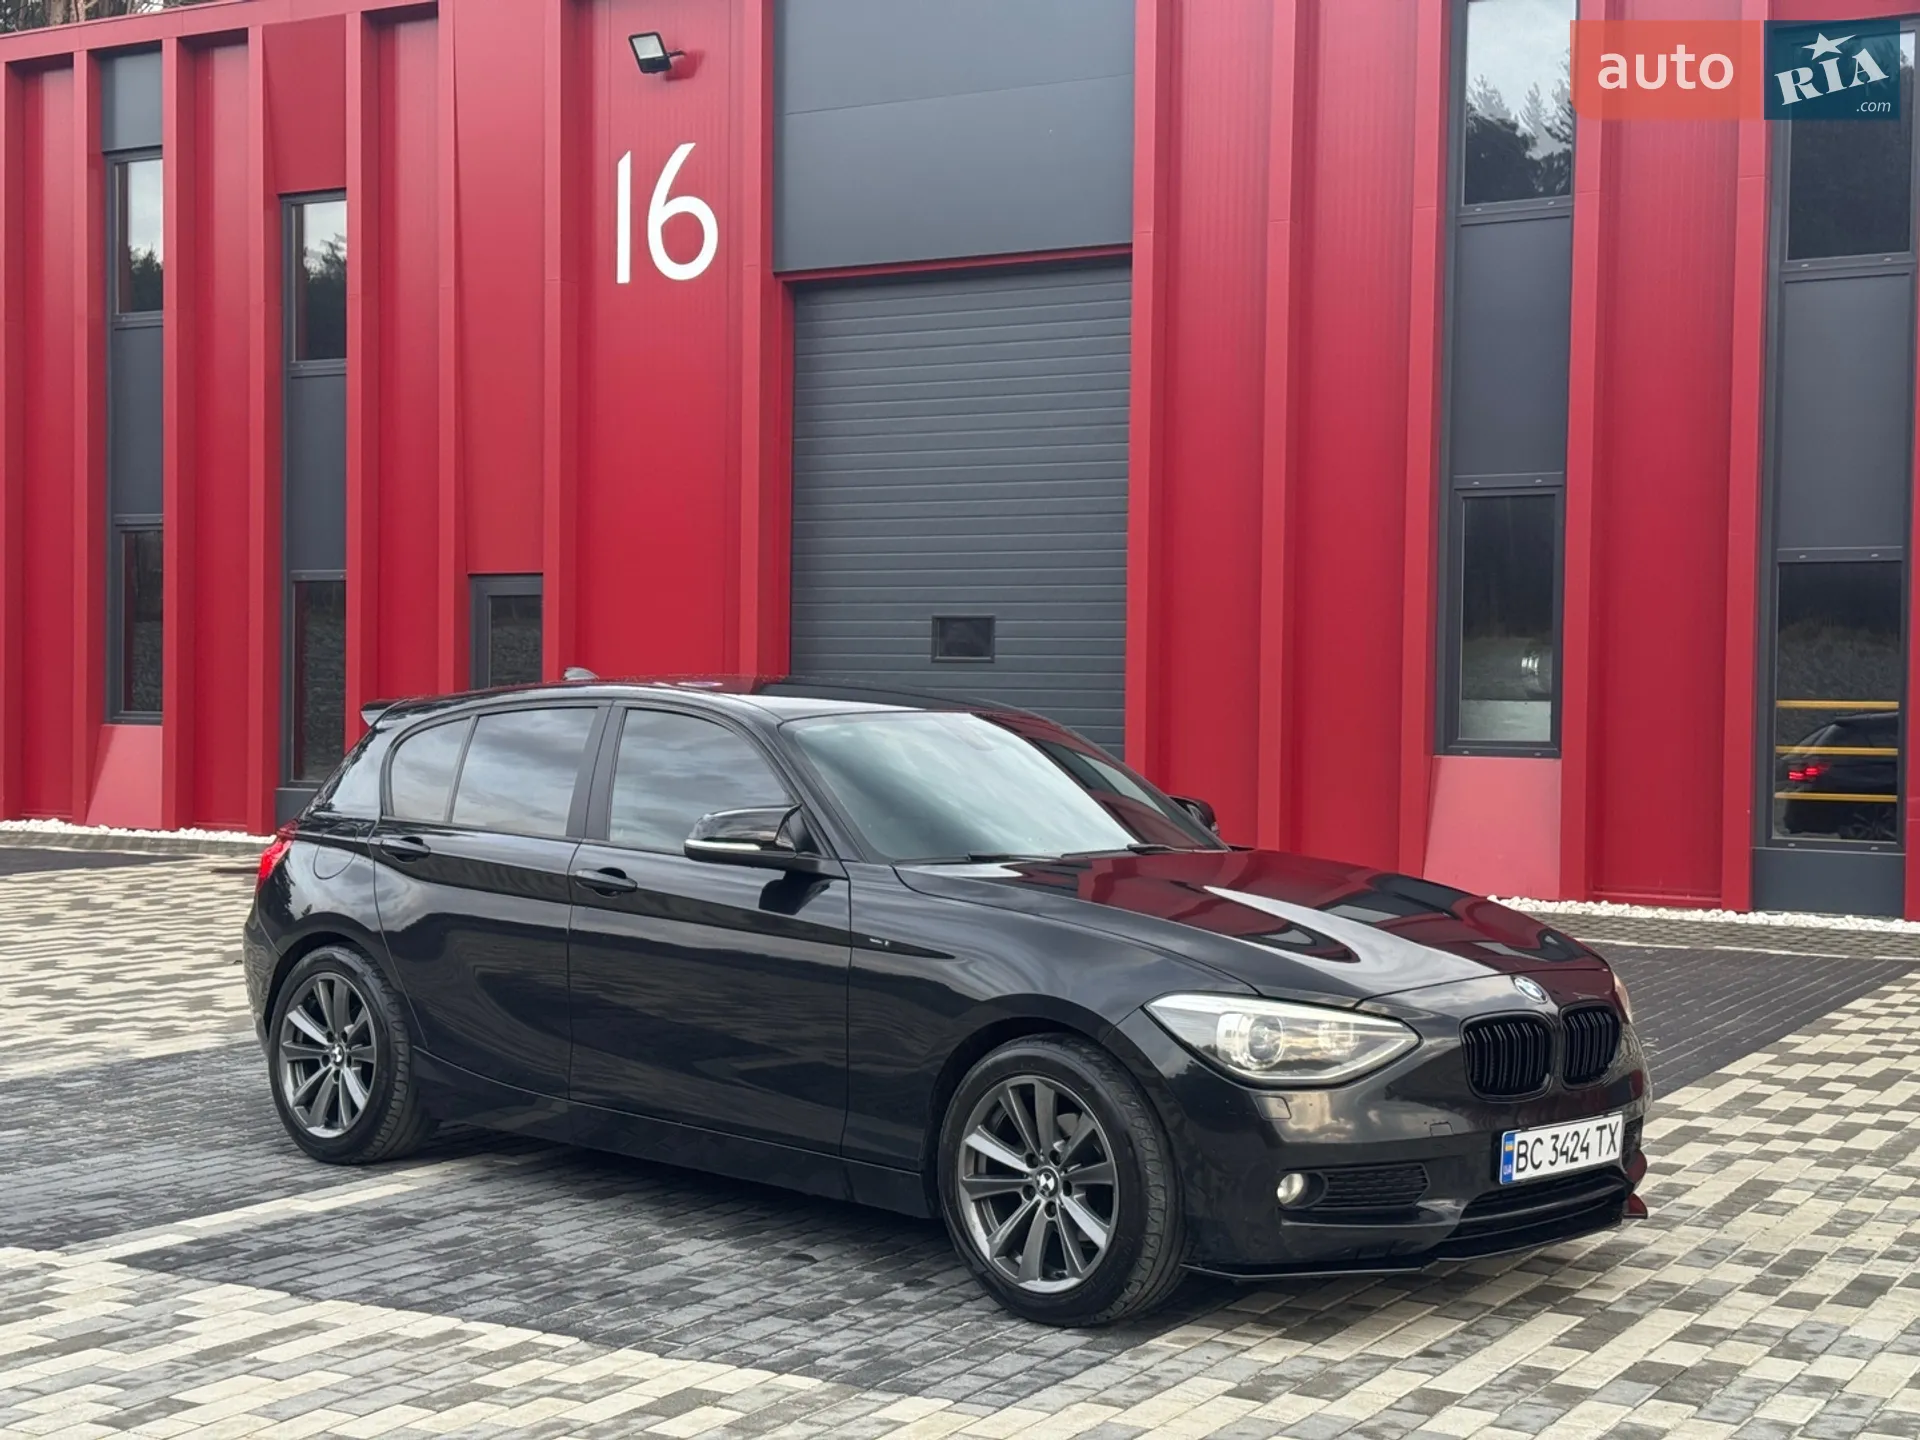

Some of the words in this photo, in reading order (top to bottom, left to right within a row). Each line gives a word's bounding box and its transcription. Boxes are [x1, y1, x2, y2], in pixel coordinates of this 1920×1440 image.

[617, 142, 718, 284] 16
[1516, 1137, 1543, 1173] BC
[1548, 1128, 1590, 1166] 3424
[1596, 1121, 1619, 1157] TX
